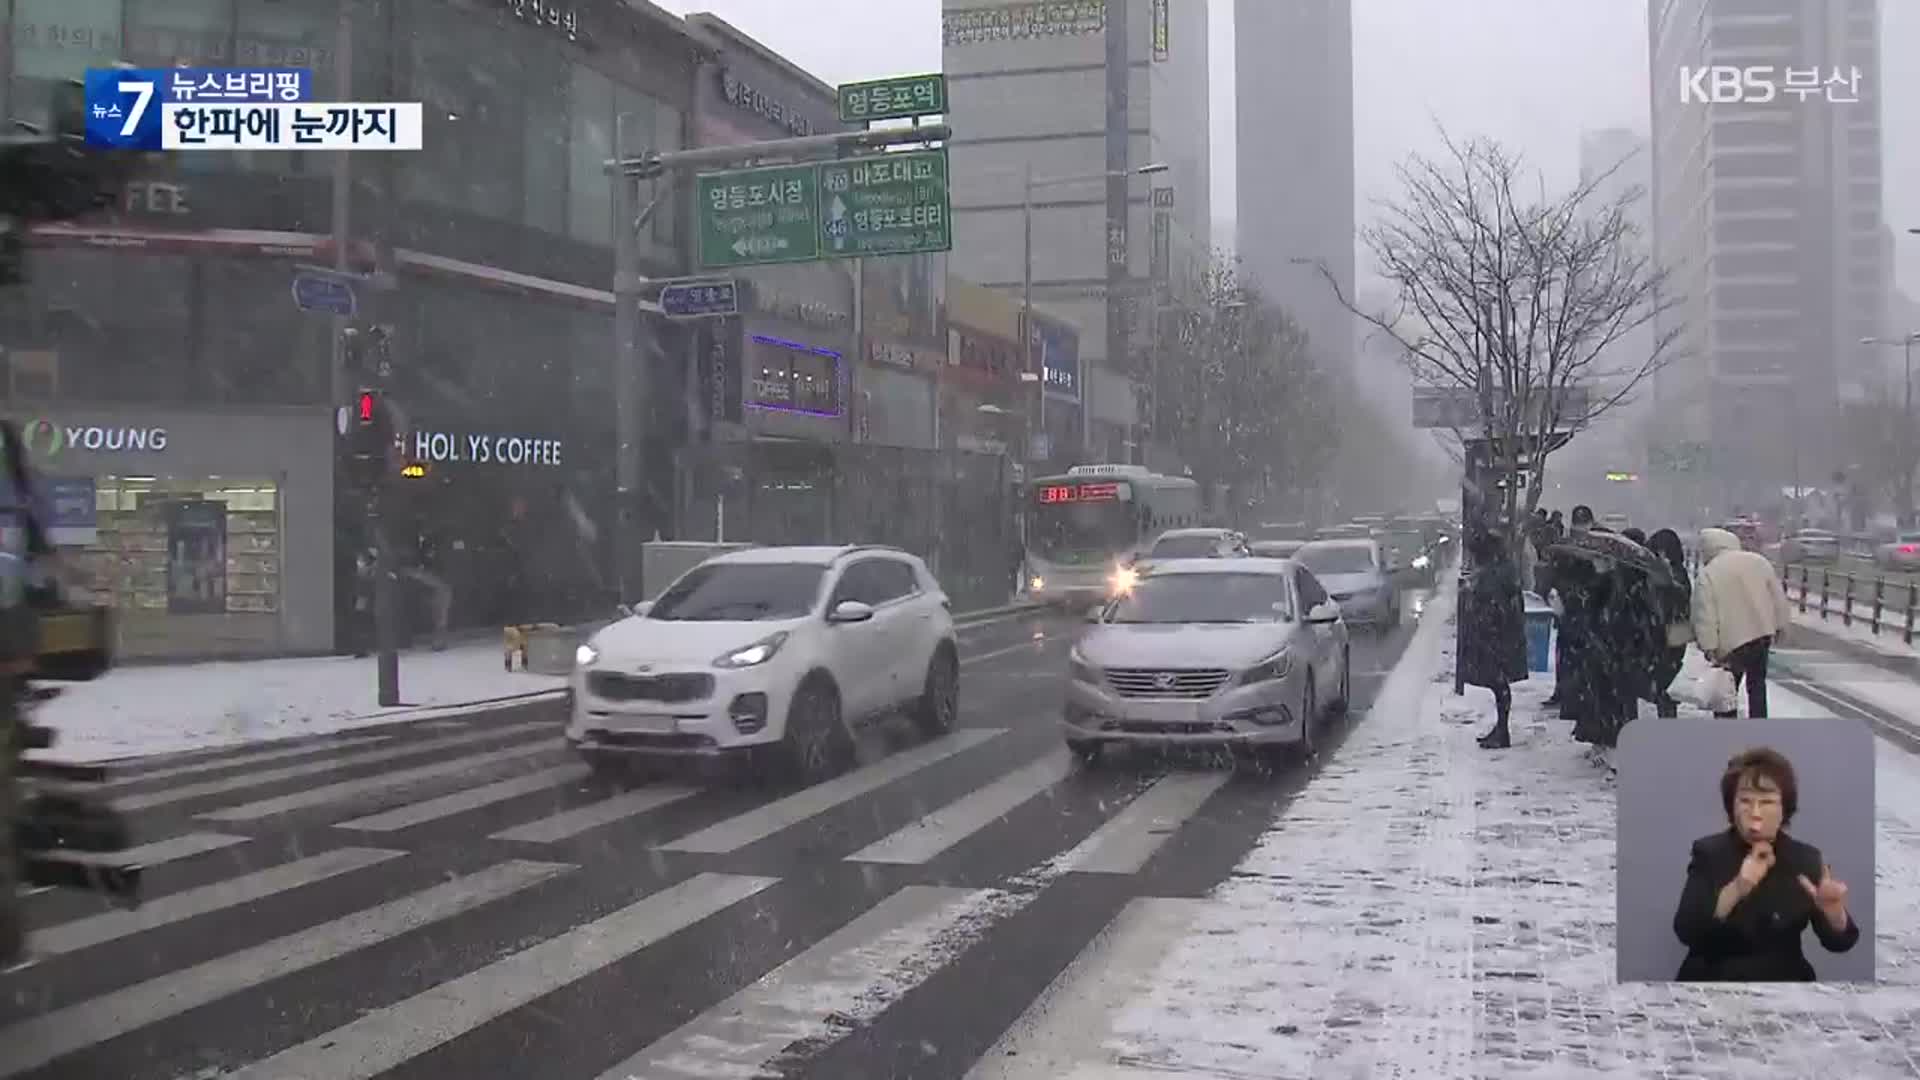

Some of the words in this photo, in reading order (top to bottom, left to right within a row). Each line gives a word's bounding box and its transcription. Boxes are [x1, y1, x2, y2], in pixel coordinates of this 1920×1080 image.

[849, 82, 935, 114] 영등포역
[853, 161, 932, 186] 마포대교
[65, 426, 168, 450] YOUNG
[496, 437, 561, 465] COFFEE
